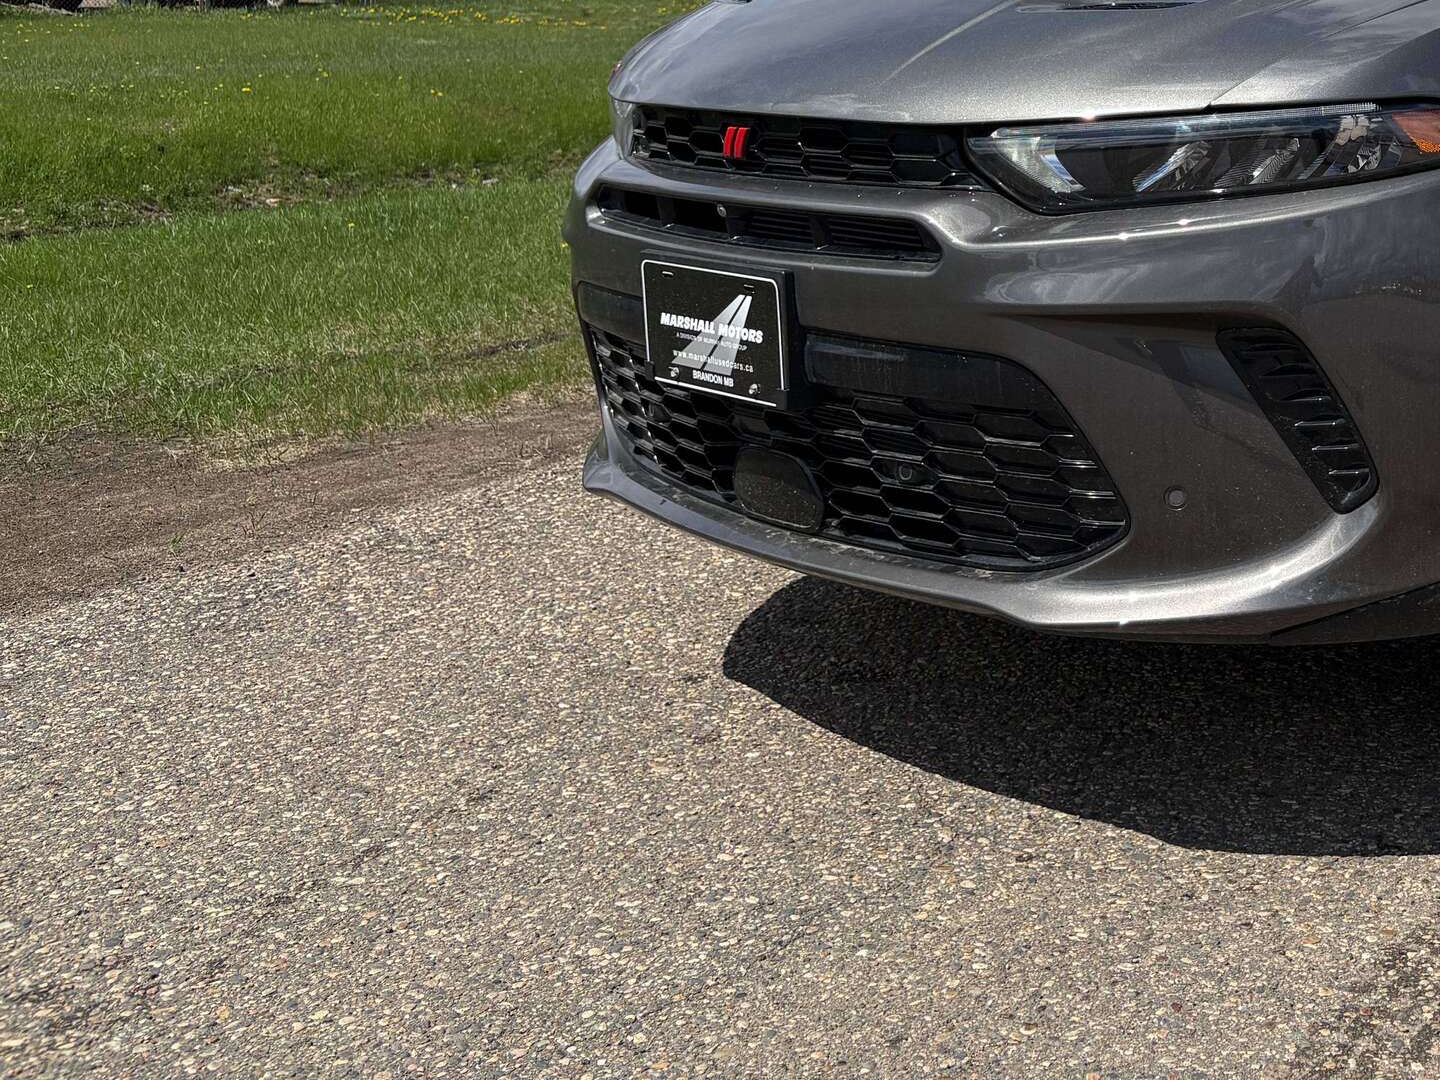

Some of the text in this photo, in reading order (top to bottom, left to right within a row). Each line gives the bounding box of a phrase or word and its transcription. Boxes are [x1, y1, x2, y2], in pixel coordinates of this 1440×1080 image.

[660, 312, 764, 344] MARSHALL MOTORS
[692, 370, 734, 387] BRANDON MB
